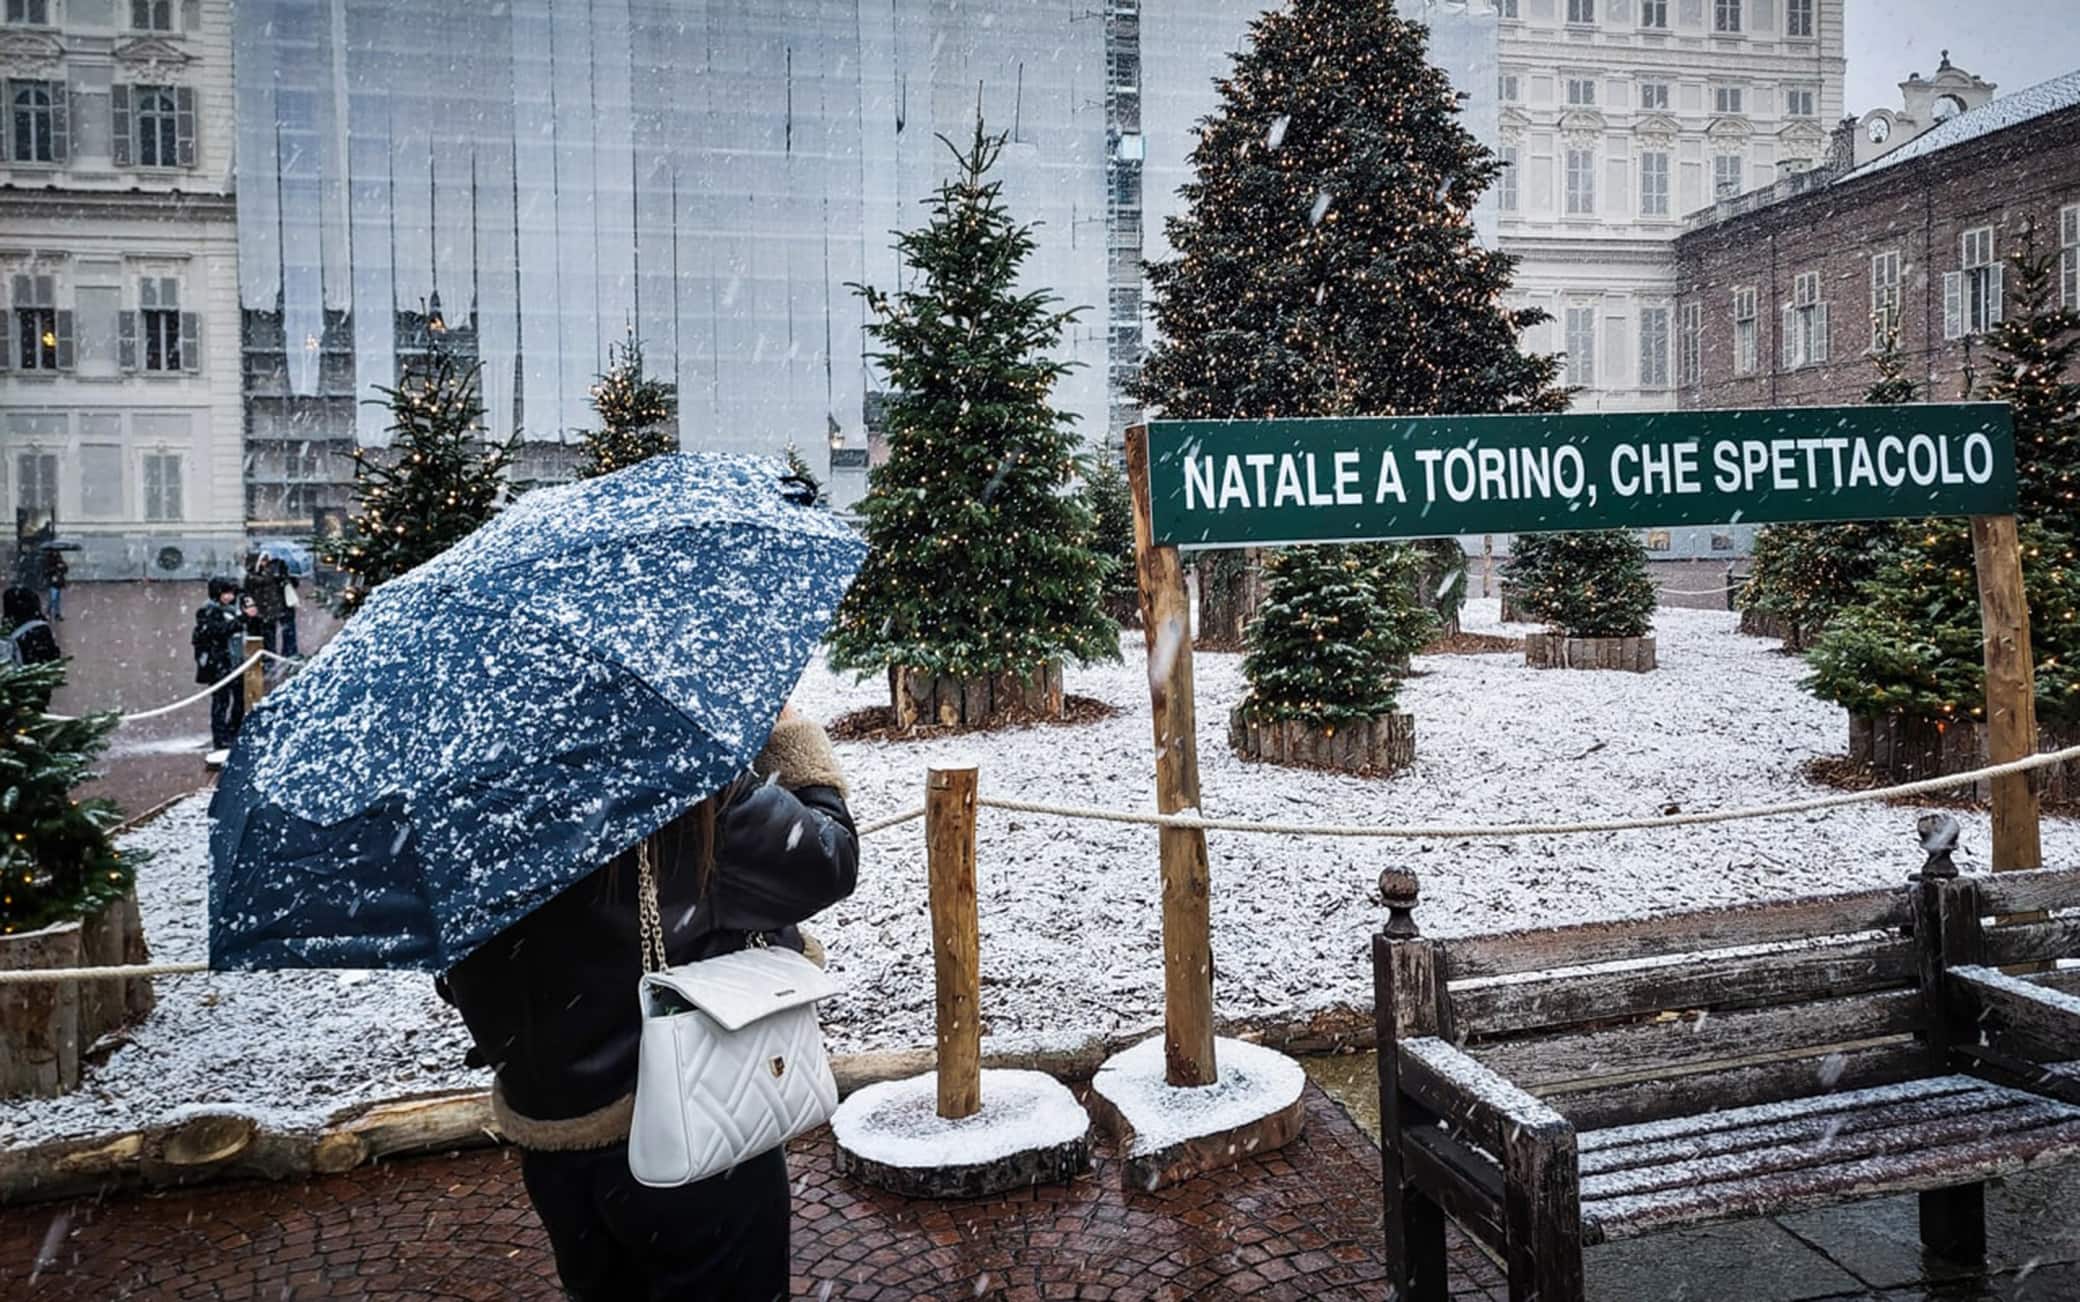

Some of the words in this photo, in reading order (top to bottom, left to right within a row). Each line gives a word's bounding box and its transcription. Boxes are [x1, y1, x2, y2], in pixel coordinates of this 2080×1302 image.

[1184, 452, 1363, 510] NATALE
[1375, 450, 1407, 504] A
[1415, 444, 1597, 508] TORINO,
[1610, 442, 1701, 497] CHE
[1713, 432, 1994, 493] SPETTACOLO
